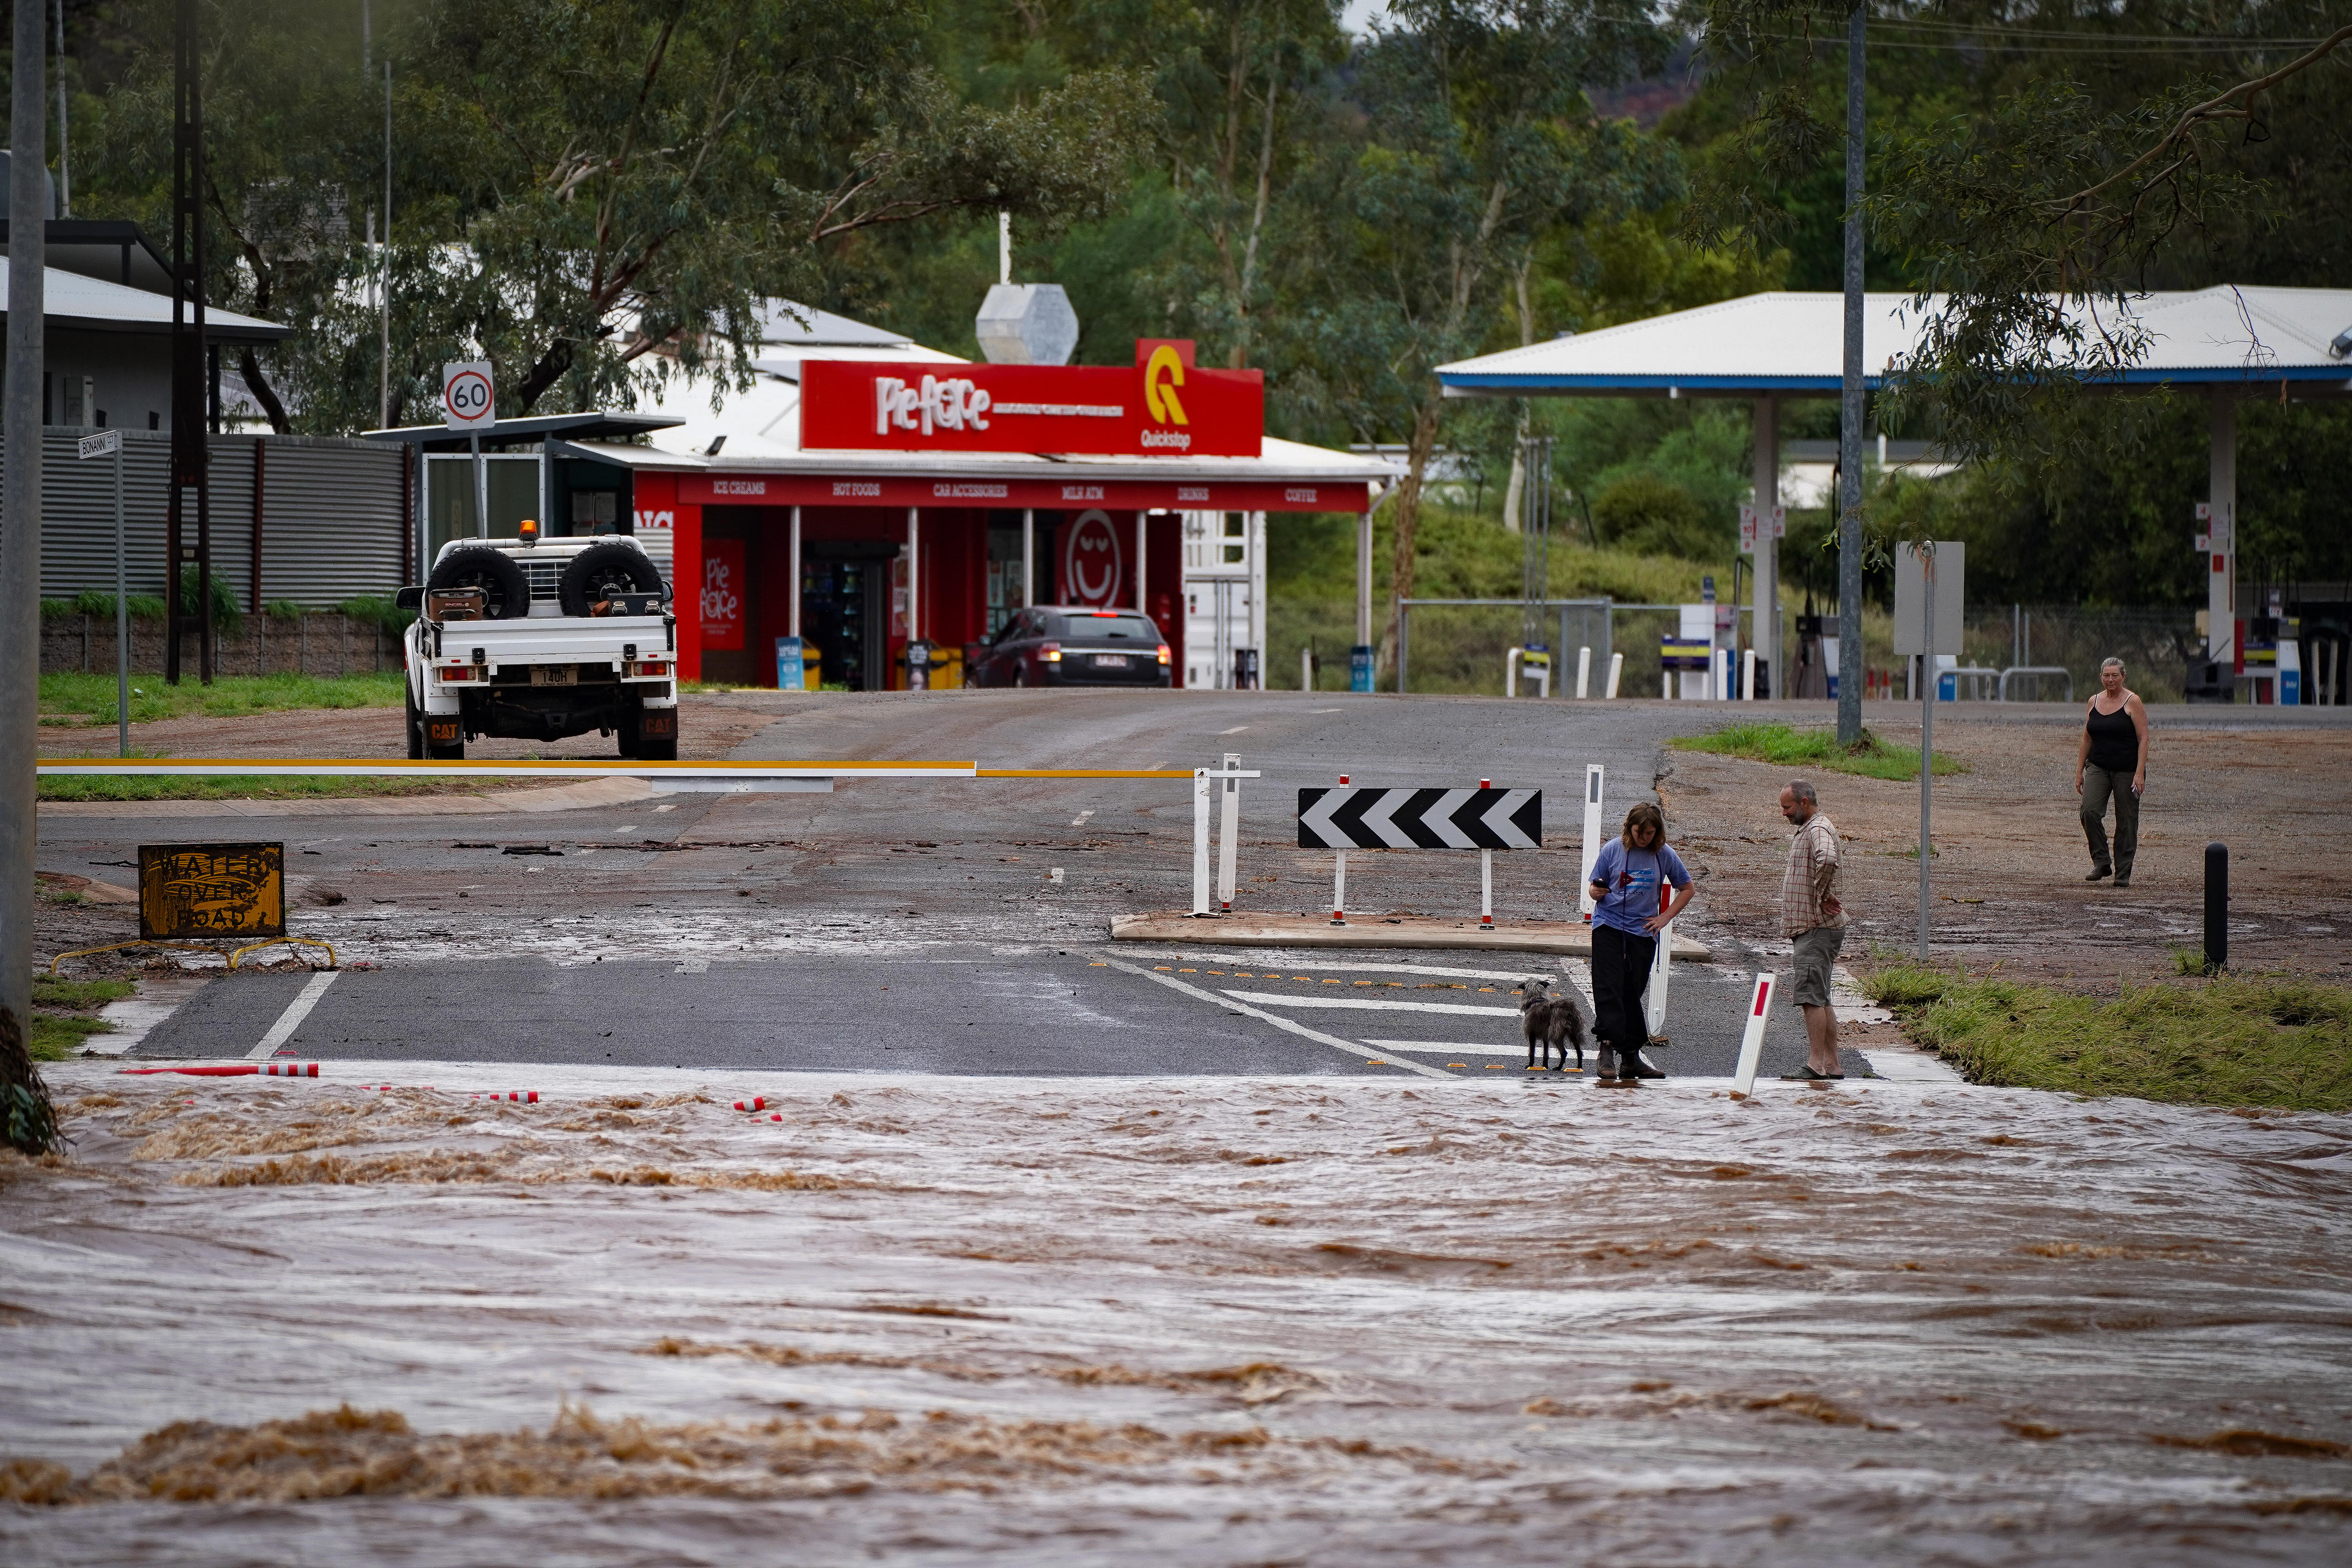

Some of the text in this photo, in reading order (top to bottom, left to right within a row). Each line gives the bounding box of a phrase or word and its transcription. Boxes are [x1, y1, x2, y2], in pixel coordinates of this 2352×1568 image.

[454, 383, 486, 408] 60
[82, 437, 106, 455] BONANNI
[1140, 429, 1192, 452] Quickstop
[713, 481, 766, 494] ICE CREAMS
[832, 483, 881, 496] HOT FOODS
[933, 484, 1008, 498] CAR ACCESSORIES
[1285, 489, 1317, 503] COFFEE
[432, 724, 457, 740] CAT
[645, 718, 671, 733] CAT
[160, 854, 262, 876] WATER
[177, 883, 246, 900] OVER
[177, 909, 246, 926] ROAD
